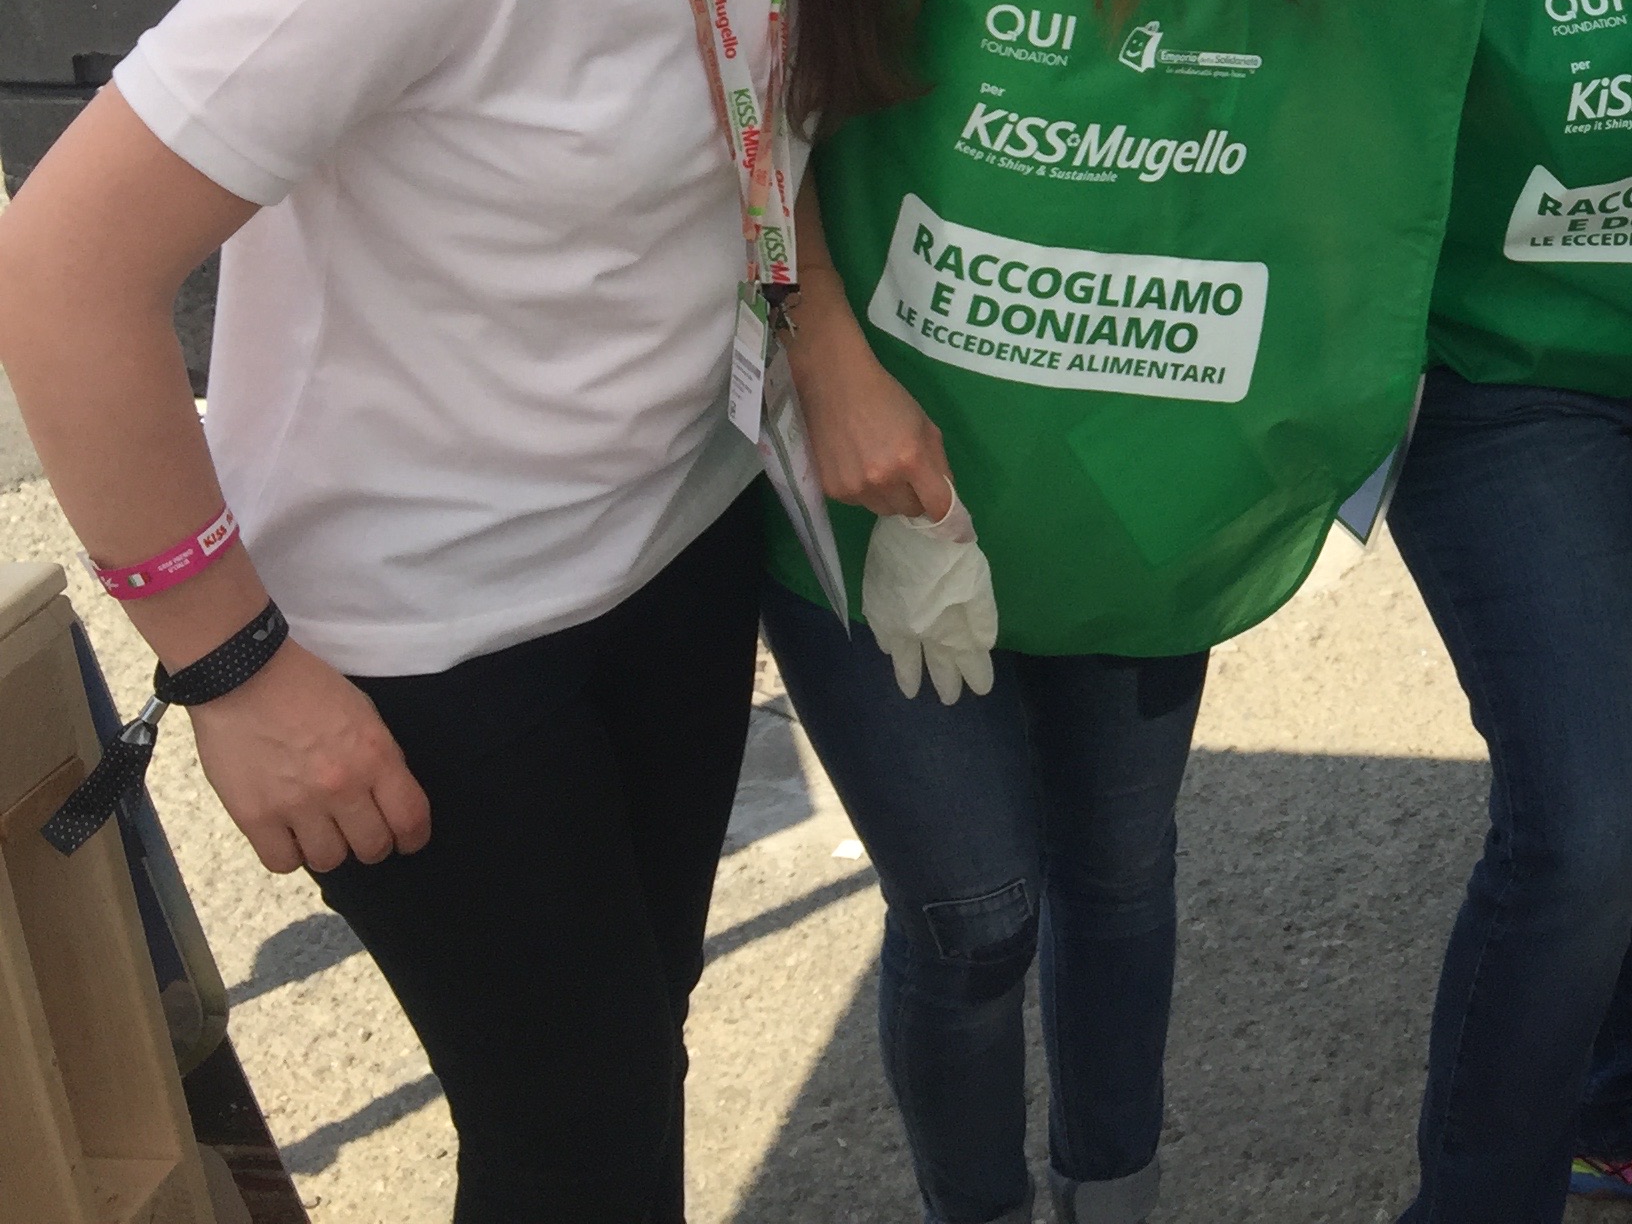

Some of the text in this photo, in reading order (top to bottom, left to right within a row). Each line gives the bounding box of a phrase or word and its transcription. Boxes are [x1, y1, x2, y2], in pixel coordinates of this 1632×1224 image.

[985, 3, 1077, 51] QUI
[1551, 14, 1628, 37] FOUNDATION
[980, 38, 1069, 68] FOUNDATION
[1570, 59, 1592, 75] per
[979, 81, 1006, 97] per
[1563, 120, 1593, 135] Keep
[953, 139, 985, 161] Keep
[998, 156, 1035, 177] Shiny
[1035, 164, 1047, 177] &
[1049, 166, 1119, 184] Sustainable
[1567, 218, 1590, 232] E
[1529, 236, 1553, 247] LE
[912, 222, 1244, 317] RACCOGLIAMO
[930, 280, 1199, 354] E DONIAMO
[894, 298, 1227, 385] LE ECCEDENZE ALIMENTARI
